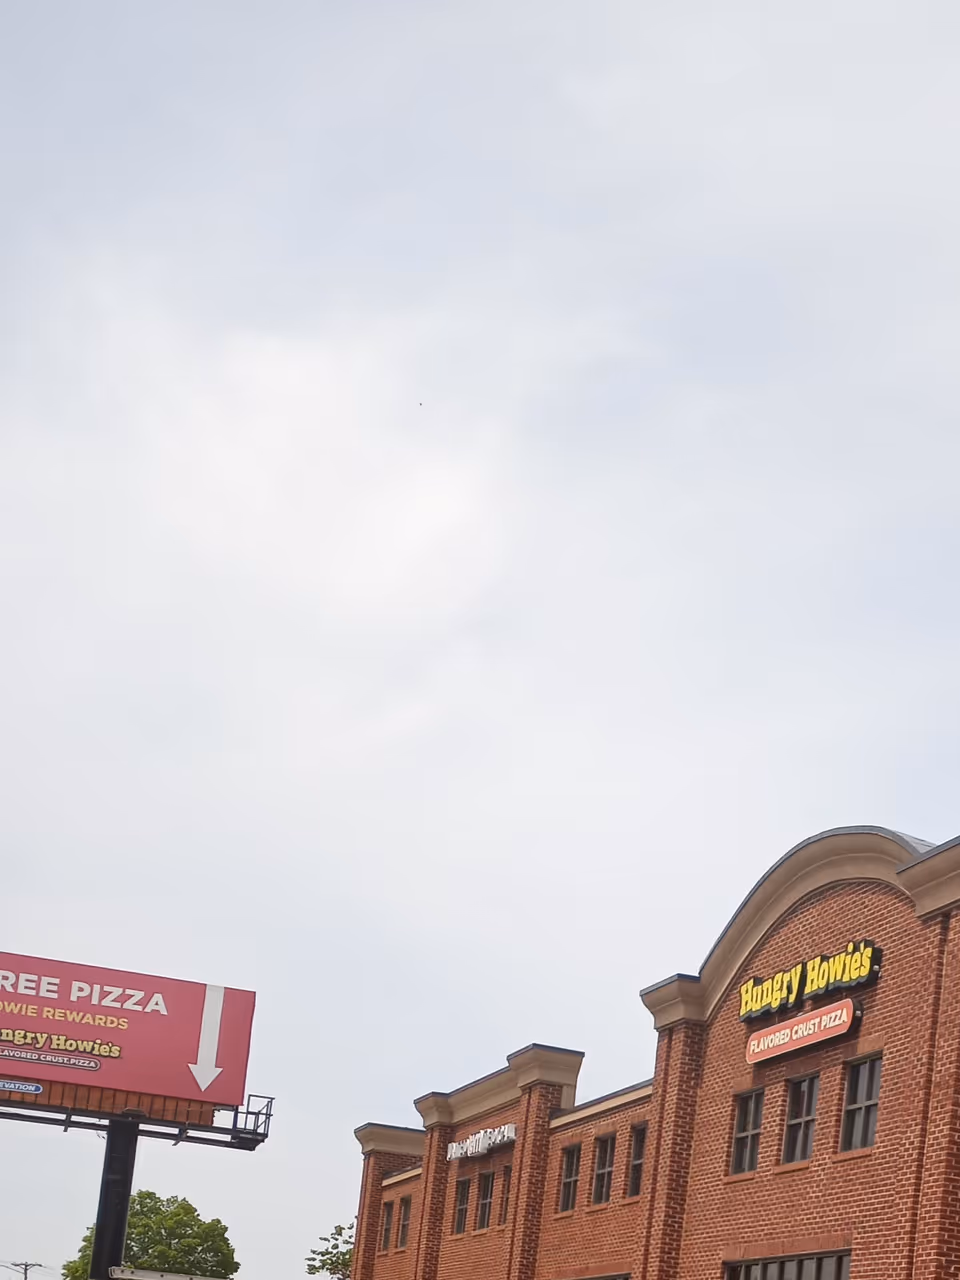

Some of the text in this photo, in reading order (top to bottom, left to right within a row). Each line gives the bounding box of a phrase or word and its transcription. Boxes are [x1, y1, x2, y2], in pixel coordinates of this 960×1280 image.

[0, 970, 168, 1015] REE PIZZA
[739, 941, 873, 1017] Hungry Howie's
[42, 1007, 129, 1030] REWARDS
[749, 1007, 848, 1055] FLAVORED CRUST PIZZA
[0, 1028, 121, 1058] ngry Howie's
[40, 1054, 68, 1064] CRUST
[70, 1059, 96, 1068] PIZZA
